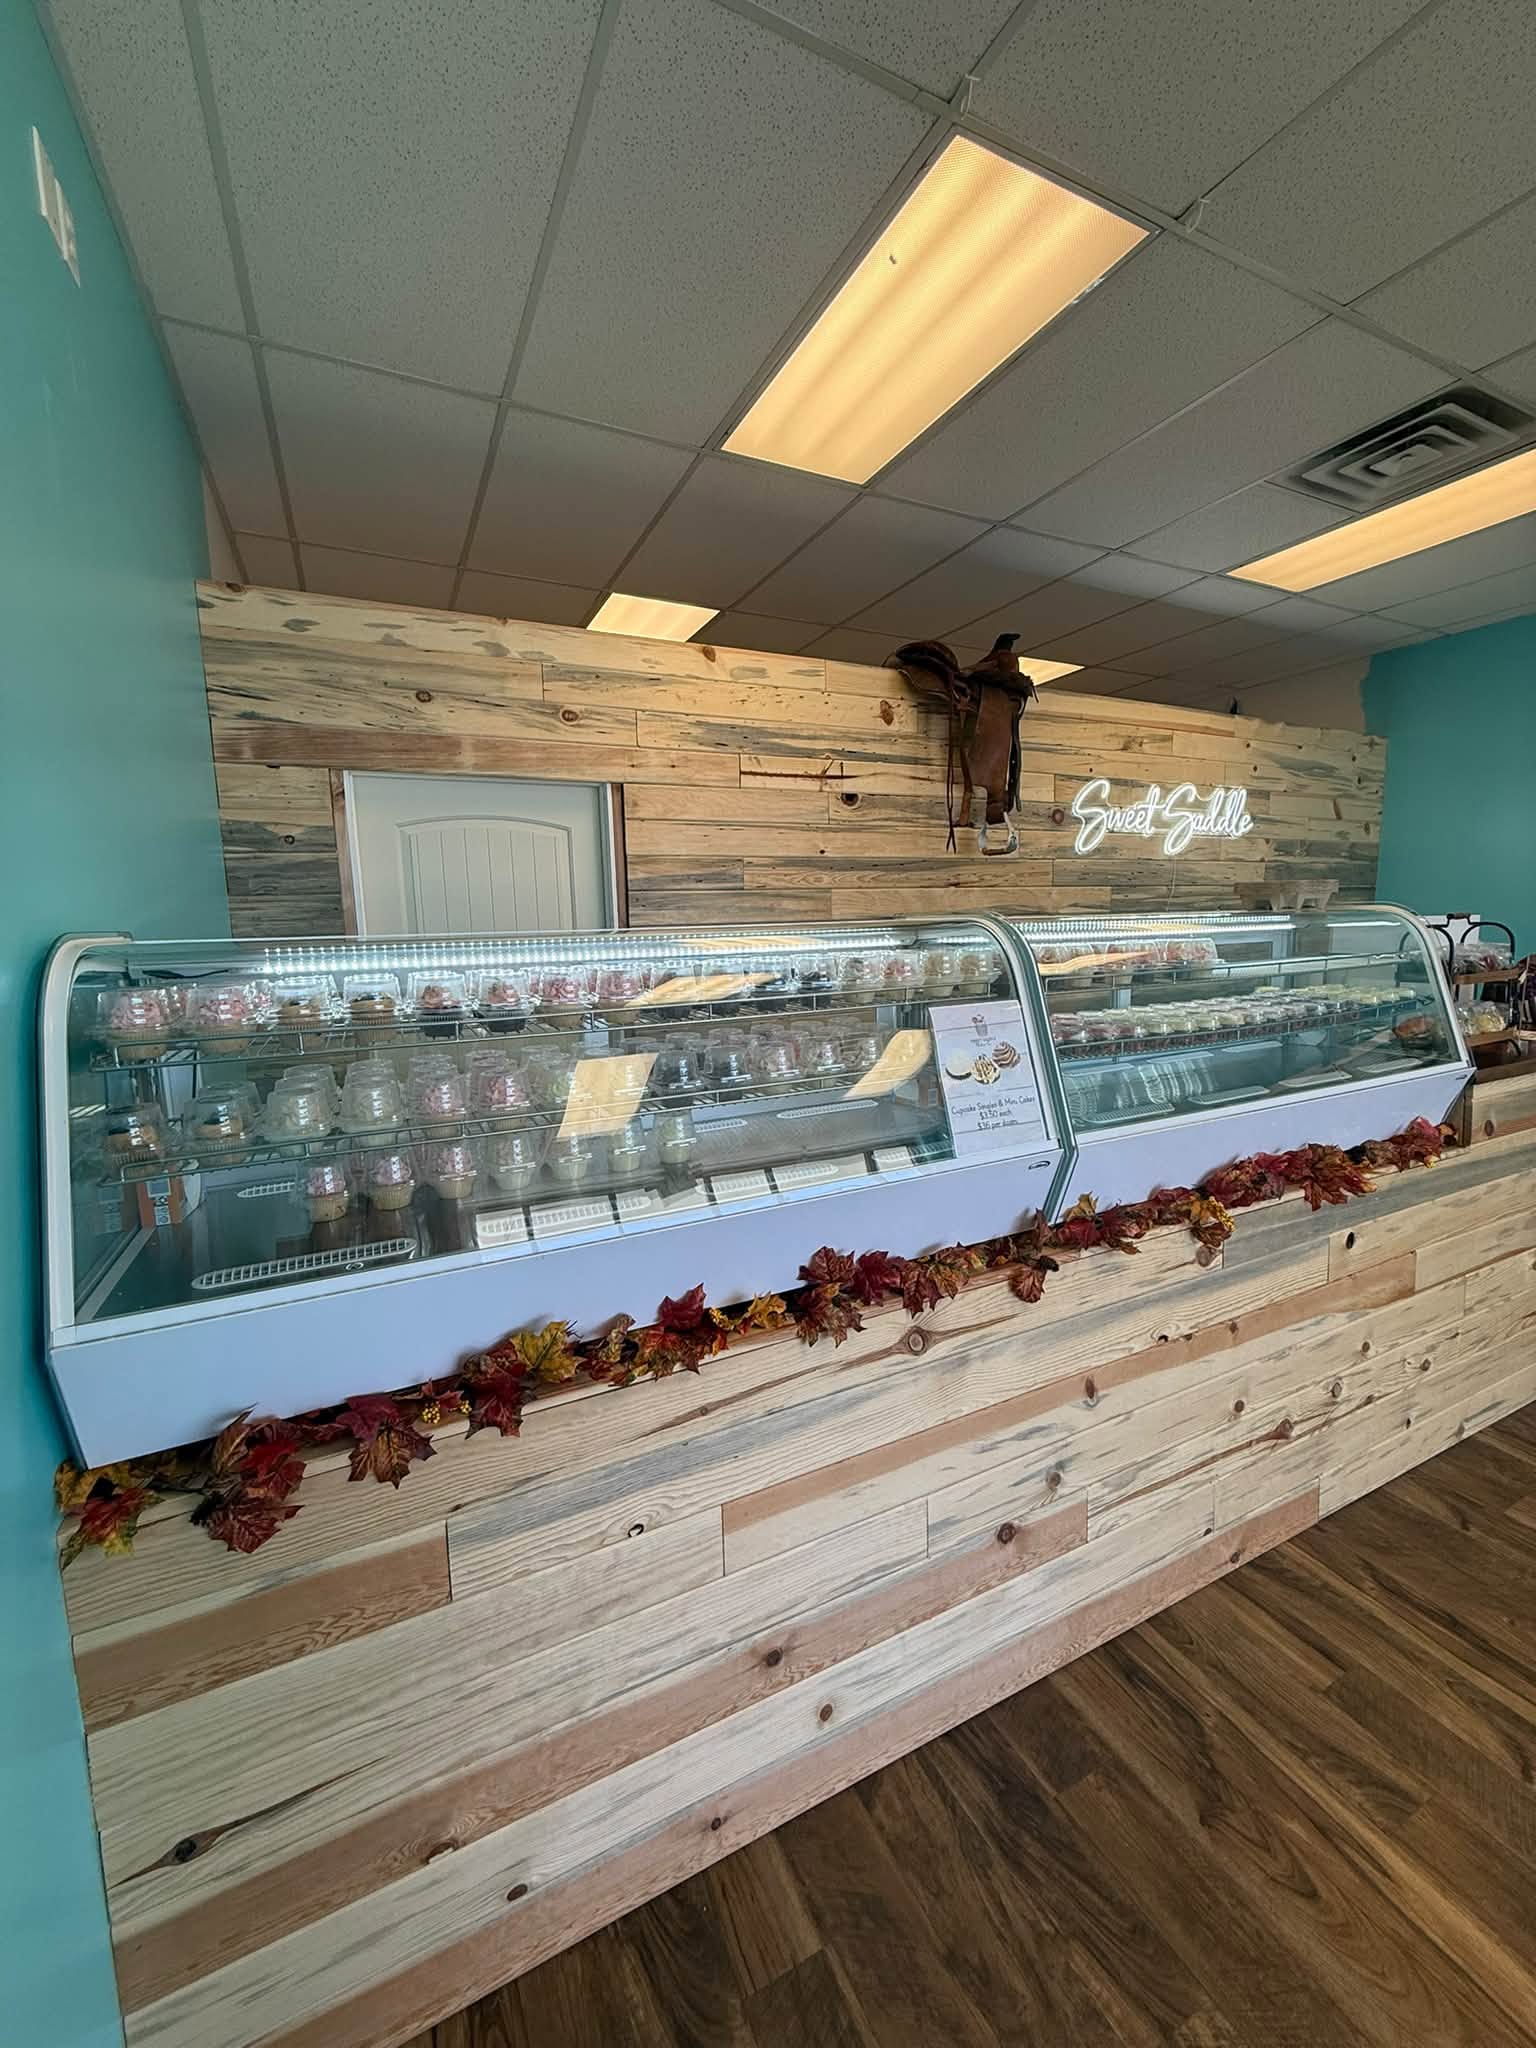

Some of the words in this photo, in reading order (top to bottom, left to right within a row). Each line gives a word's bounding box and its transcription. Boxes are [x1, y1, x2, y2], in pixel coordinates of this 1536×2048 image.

[1072, 778, 1161, 855] Sweet
[1164, 783, 1254, 856] Saddle
[951, 1105, 976, 1116] Cupcake
[998, 1099, 1003, 1107] &
